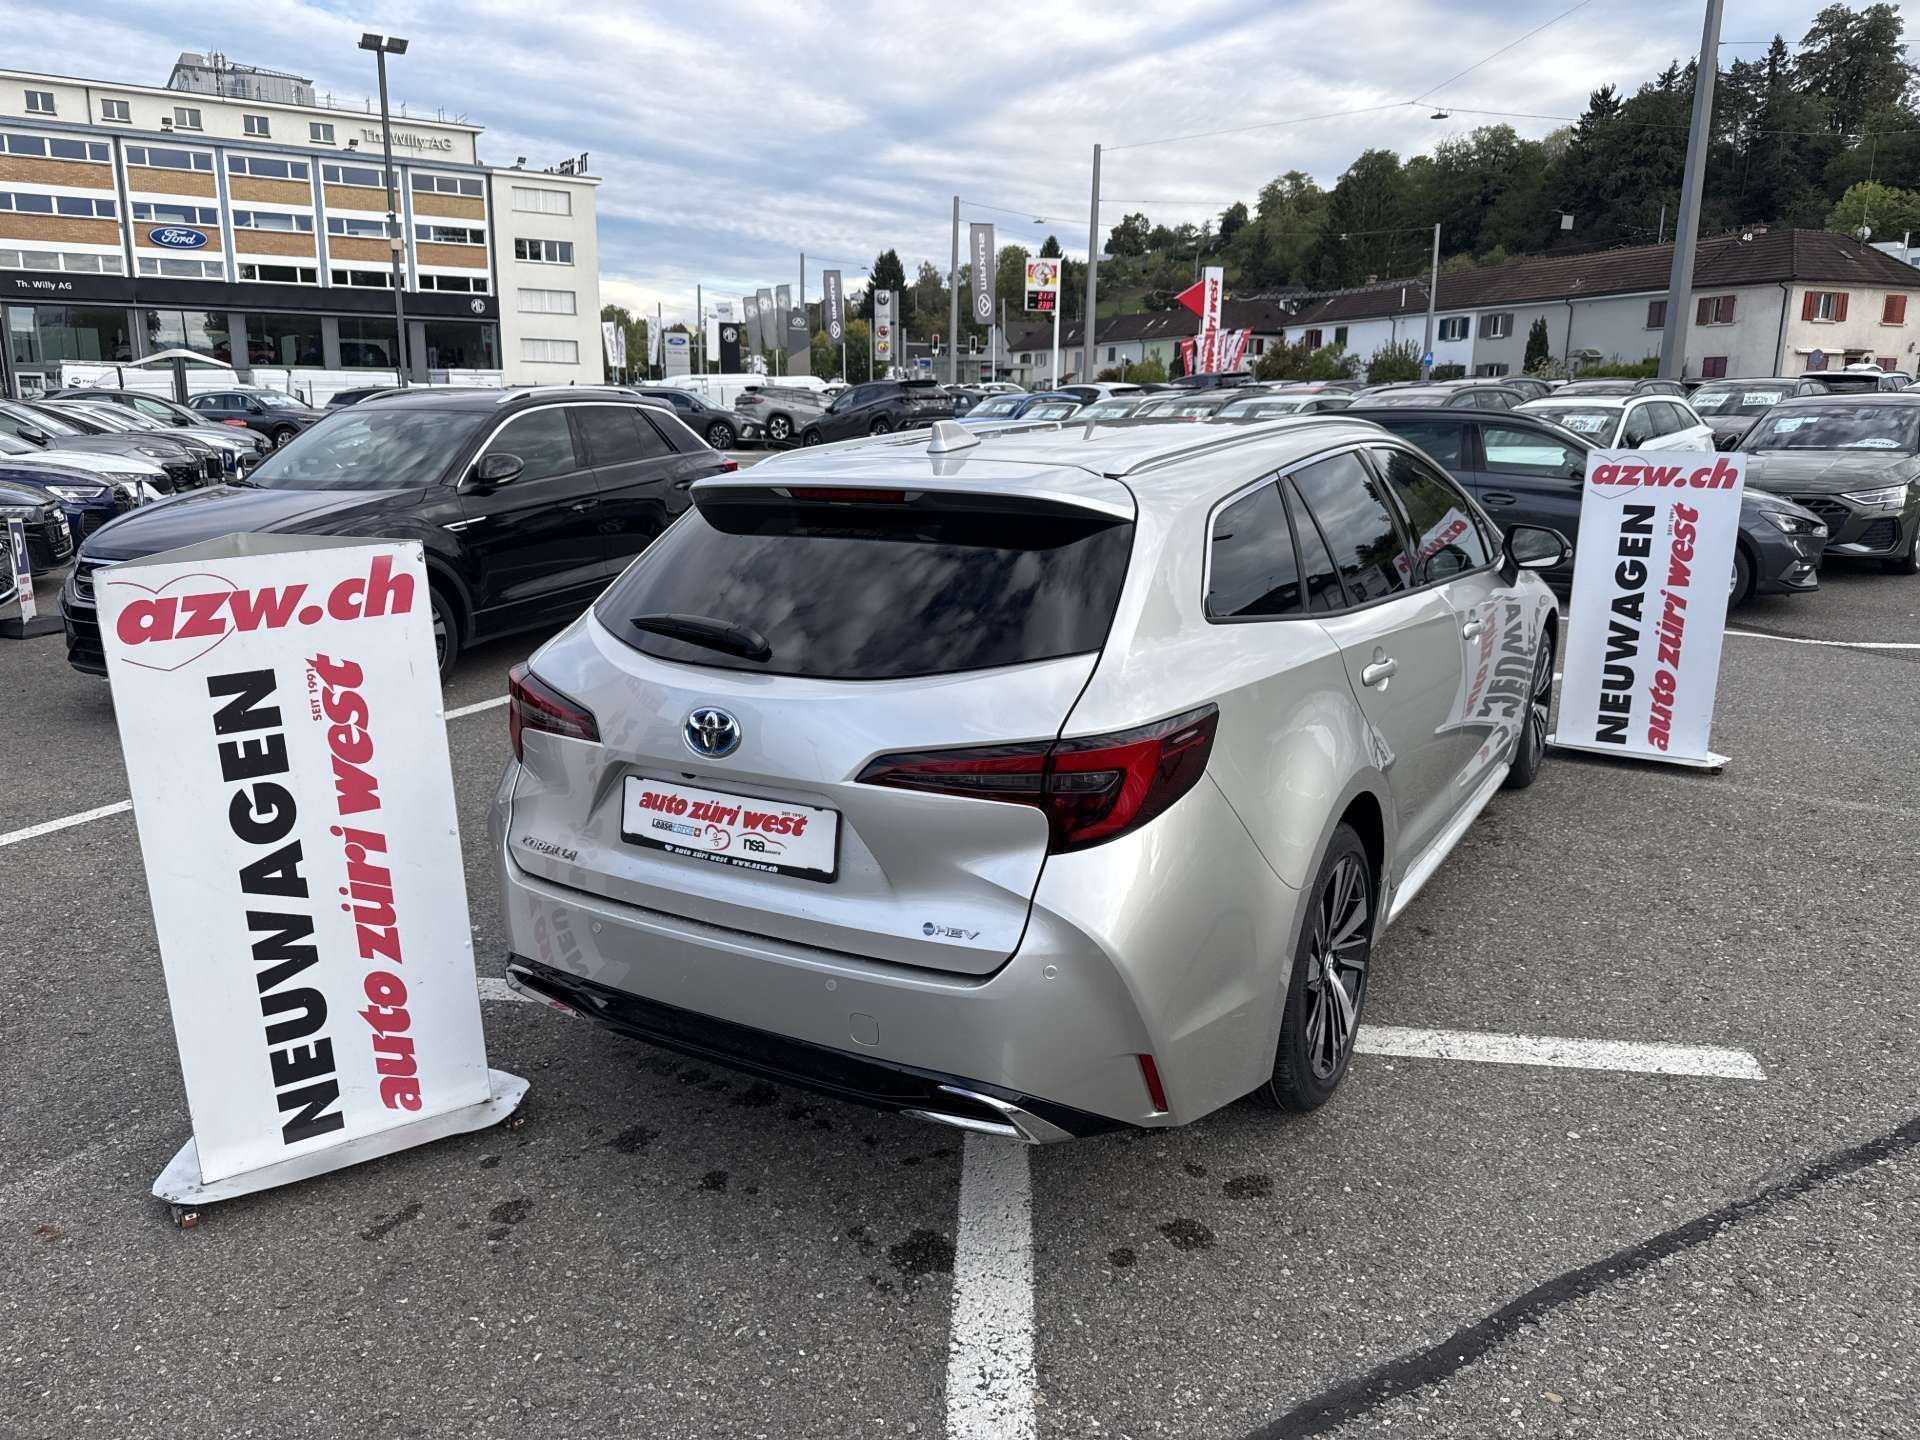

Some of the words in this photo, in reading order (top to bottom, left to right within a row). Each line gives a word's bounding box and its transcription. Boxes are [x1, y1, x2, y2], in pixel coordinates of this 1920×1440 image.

[361, 127, 389, 143] Th
[391, 129, 426, 152] Willy
[430, 136, 455, 152] AG
[161, 229, 197, 244] Ford
[1742, 233, 1753, 241] 48
[15, 279, 30, 288] Th.
[32, 280, 56, 291] Willy
[58, 281, 72, 290] AG
[722, 327, 738, 343] MG
[1591, 457, 1738, 490] azw.ch
[13, 532, 23, 568] P
[1667, 502, 1700, 588] west
[116, 555, 415, 645] azw.ch
[1595, 504, 1656, 745] NEUWAGEN
[1655, 588, 1688, 670] züri
[306, 668, 318, 694] 1991
[311, 699, 323, 721] SEIT
[1647, 672, 1677, 751] auto
[304, 652, 384, 819] west
[638, 791, 689, 816] auto
[687, 800, 742, 826] züri
[743, 810, 808, 836] west
[522, 836, 578, 862] COROLLA
[675, 847, 692, 855] auto
[710, 854, 728, 863] west
[732, 859, 779, 873] www.azw.ch
[743, 838, 765, 853] nsa
[206, 667, 345, 1146] NEUWAGEN
[328, 823, 405, 965] züri
[935, 925, 981, 941] HEV
[358, 969, 423, 1112] auto
